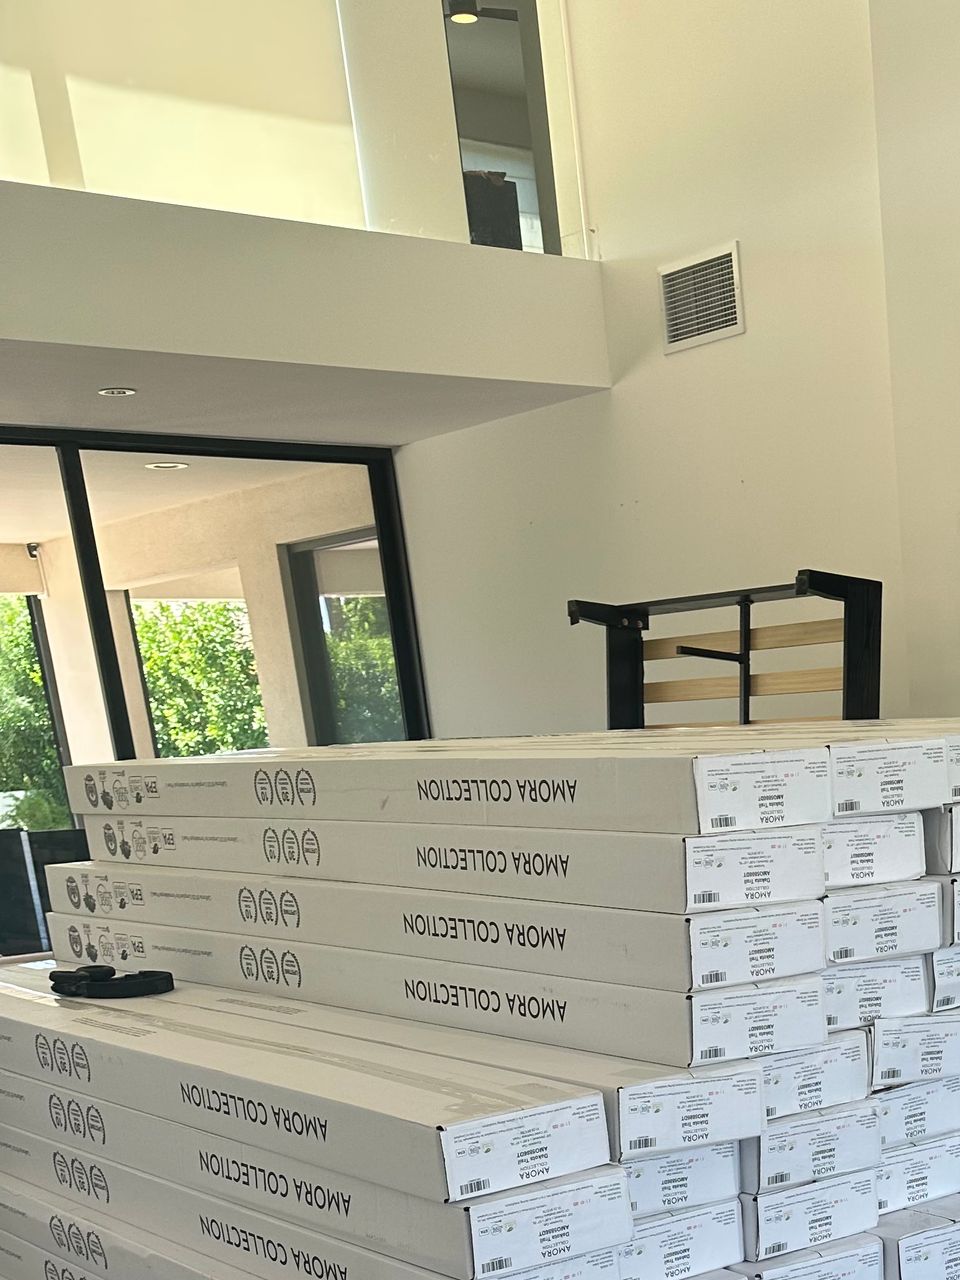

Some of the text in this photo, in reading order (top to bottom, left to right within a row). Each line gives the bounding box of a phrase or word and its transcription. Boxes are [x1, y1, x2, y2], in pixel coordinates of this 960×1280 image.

[145, 781, 157, 793] EPA
[417, 780, 577, 803] AMORA COLLECTION
[882, 799, 904, 807] AMORA
[760, 815, 785, 823] AMORA
[163, 833, 174, 845] EPA
[417, 847, 569, 878] AMORA COLLECTION
[130, 888, 142, 901] EPA
[745, 890, 771, 899] AMORA
[403, 914, 566, 951] AMORA COLLECTION
[132, 941, 144, 953] EPA
[876, 944, 897, 953] AMORA
[750, 967, 776, 976] AMORA
[405, 979, 567, 1022] AMORA COLLECTION
[749, 1044, 774, 1053] AMORA
[799, 1099, 822, 1110] AMORA
[180, 1082, 327, 1142] AMORA COLLECTION
[682, 1133, 708, 1144] AMORA
[519, 1166, 550, 1179] AMORA
[812, 1166, 835, 1176] AMORA
[199, 1150, 351, 1217] AMORA COLLECTION
[662, 1195, 688, 1207] AMORA
[199, 1215, 287, 1265] COLLECTION
[809, 1233, 832, 1244] AMORA
[541, 1244, 571, 1259] AMORA
[665, 1266, 691, 1278] AMORA
